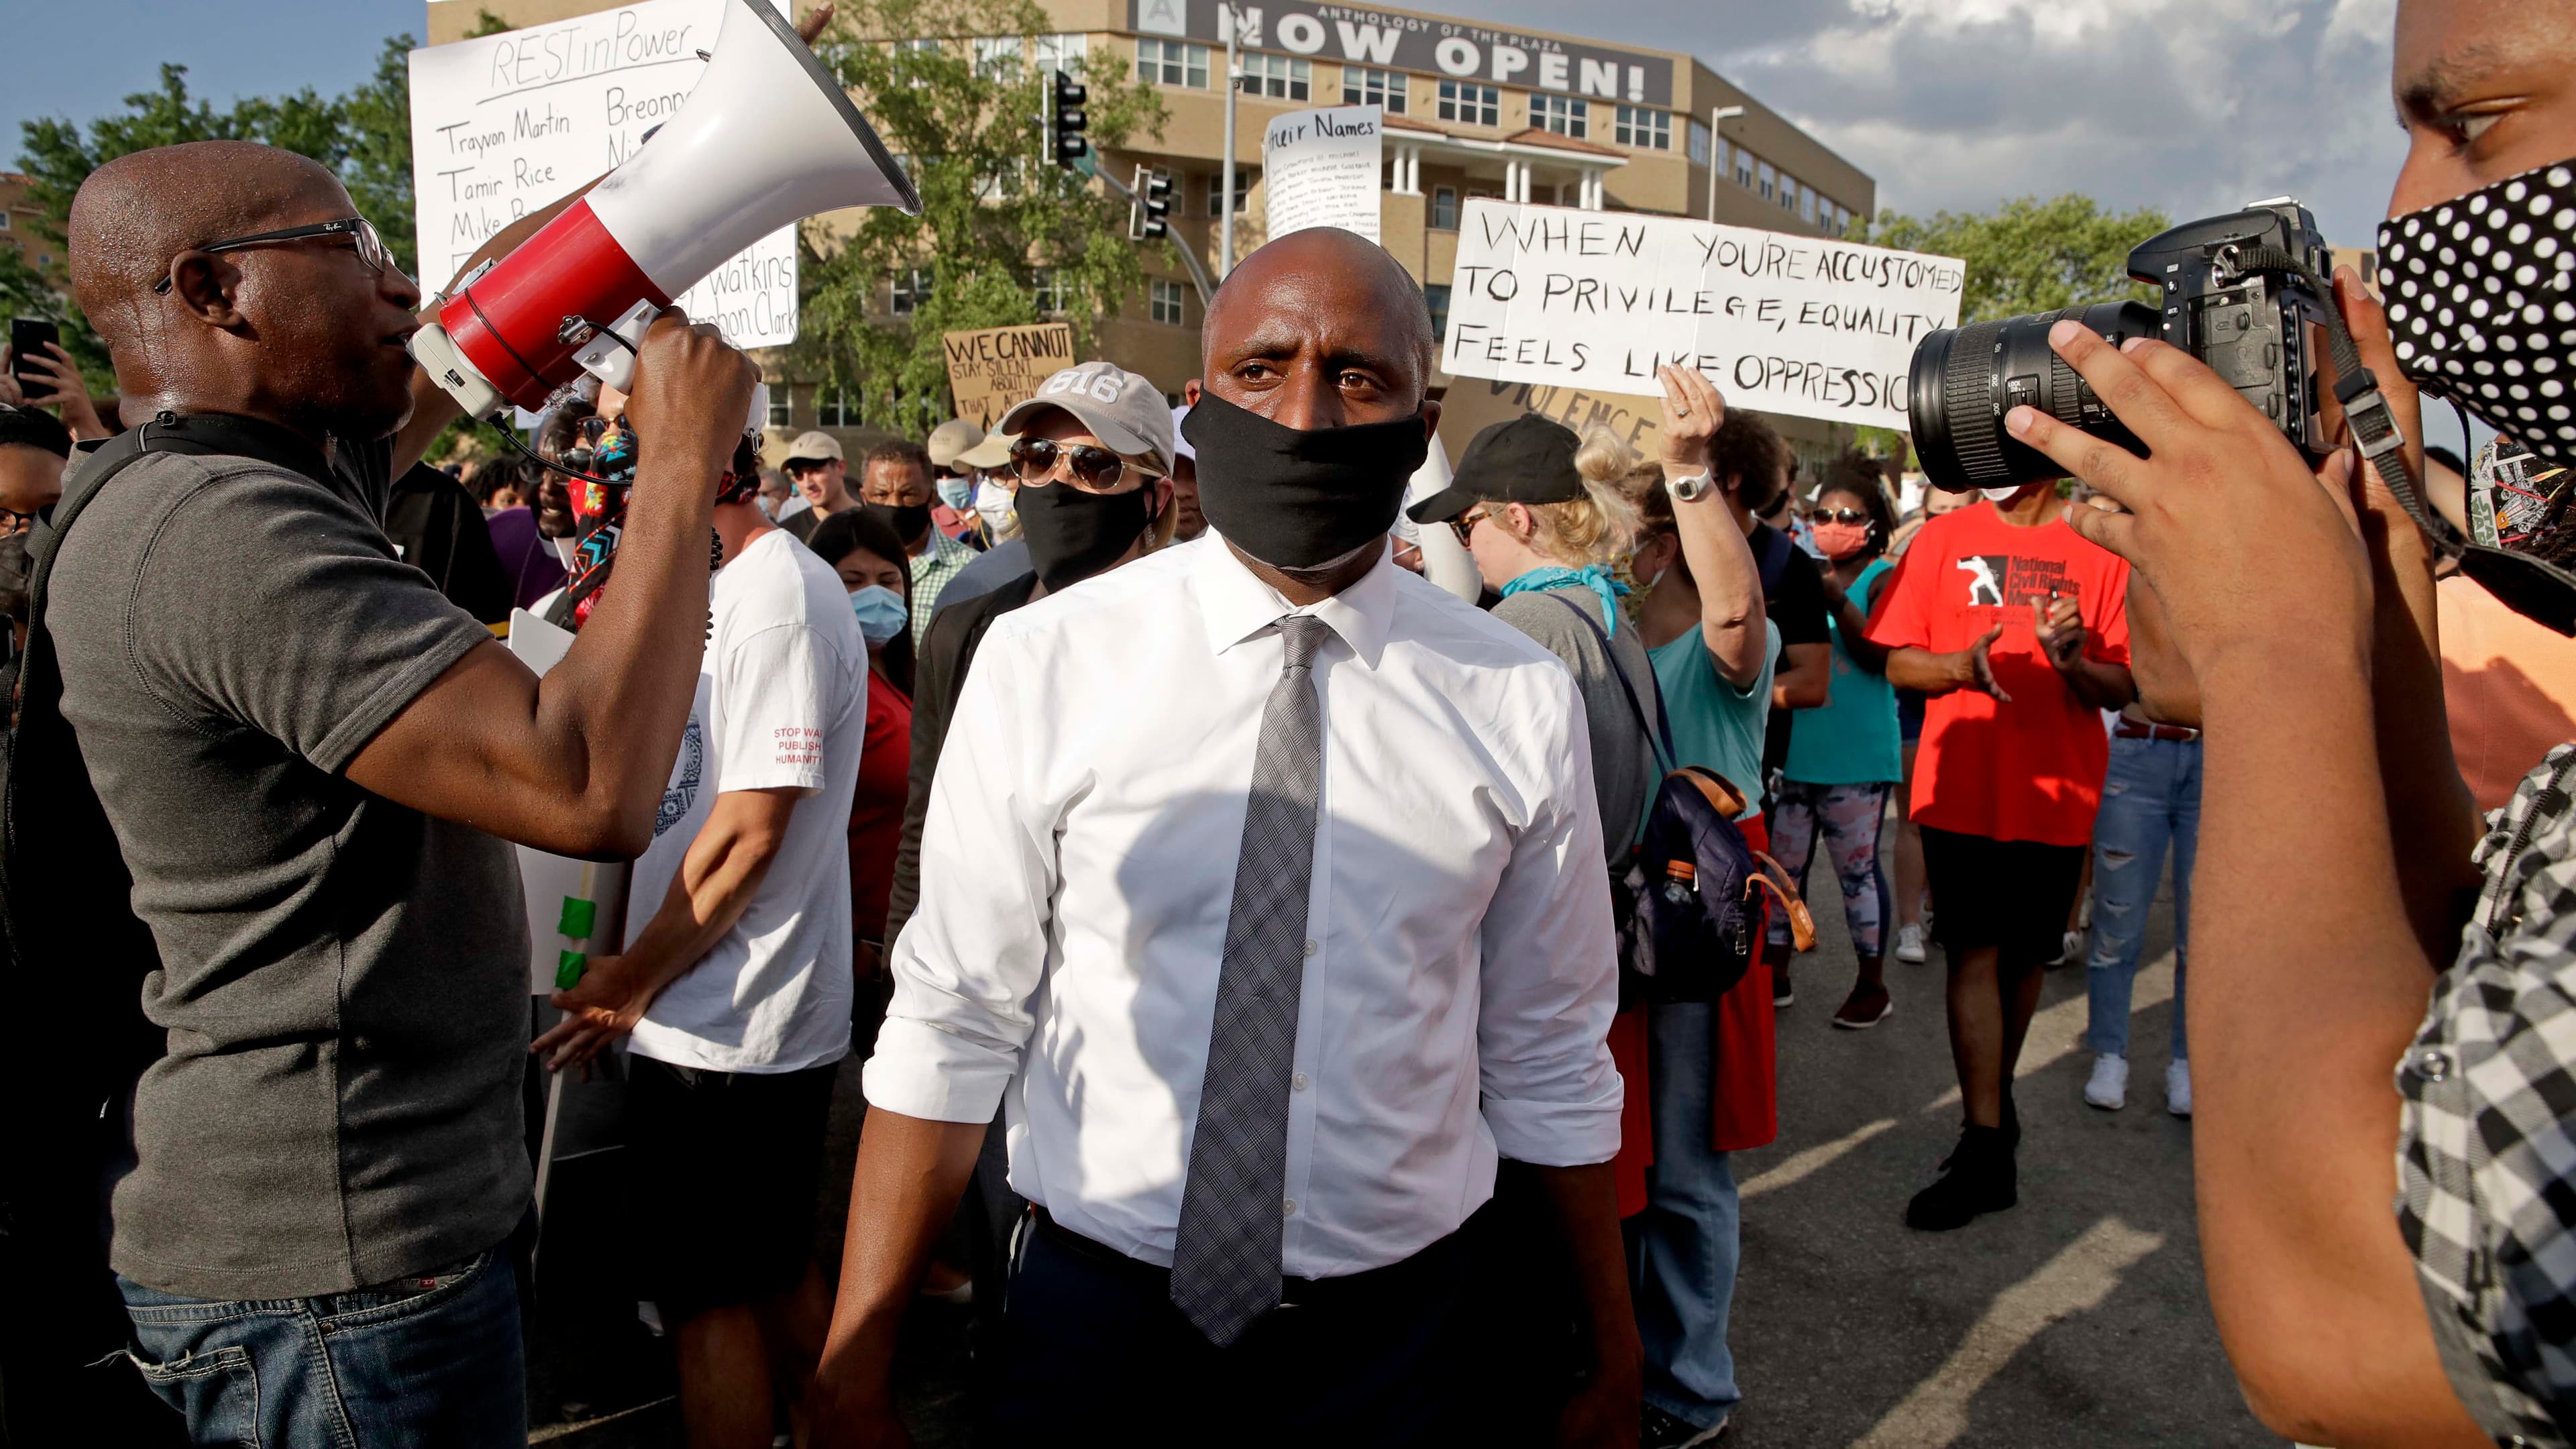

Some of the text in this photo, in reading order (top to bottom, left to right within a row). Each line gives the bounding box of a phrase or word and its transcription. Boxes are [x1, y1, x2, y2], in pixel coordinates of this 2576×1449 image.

[613, 11, 692, 67] Power
[1317, 5, 1562, 53] ANTHOLOGY OF THE PLAZA
[1217, 2, 1645, 103] NOW OPEN!
[436, 102, 570, 160] Trayvon Martin
[1315, 113, 1374, 138] Names
[437, 158, 555, 202] Tamir Rice
[451, 206, 500, 246] Mike
[710, 244, 793, 296] Watkins
[1481, 211, 1962, 294] WHEN YOU'RE ACCUSTOMED
[755, 288, 797, 335] Clark
[1459, 266, 1947, 343] TO PRIVILEGE, EQUALITY
[944, 327, 1069, 362] WE CANNOT
[1994, 342, 2002, 353] 105
[951, 357, 1032, 380] STAY SILENT
[990, 374, 1022, 391] ABOUT
[1454, 323, 1591, 372] FEELS
[1734, 354, 1908, 412] OPPRESSIO
[958, 394, 990, 414] THAT
[1046, 370, 1124, 403] 816
[2471, 496, 2487, 545] WAR
[2011, 555, 2066, 575] National
[2010, 572, 2081, 596] Civil Rights
[774, 727, 801, 738] STOP
[779, 741, 821, 752] PUBLISH
[775, 754, 822, 765] HUMANITY
